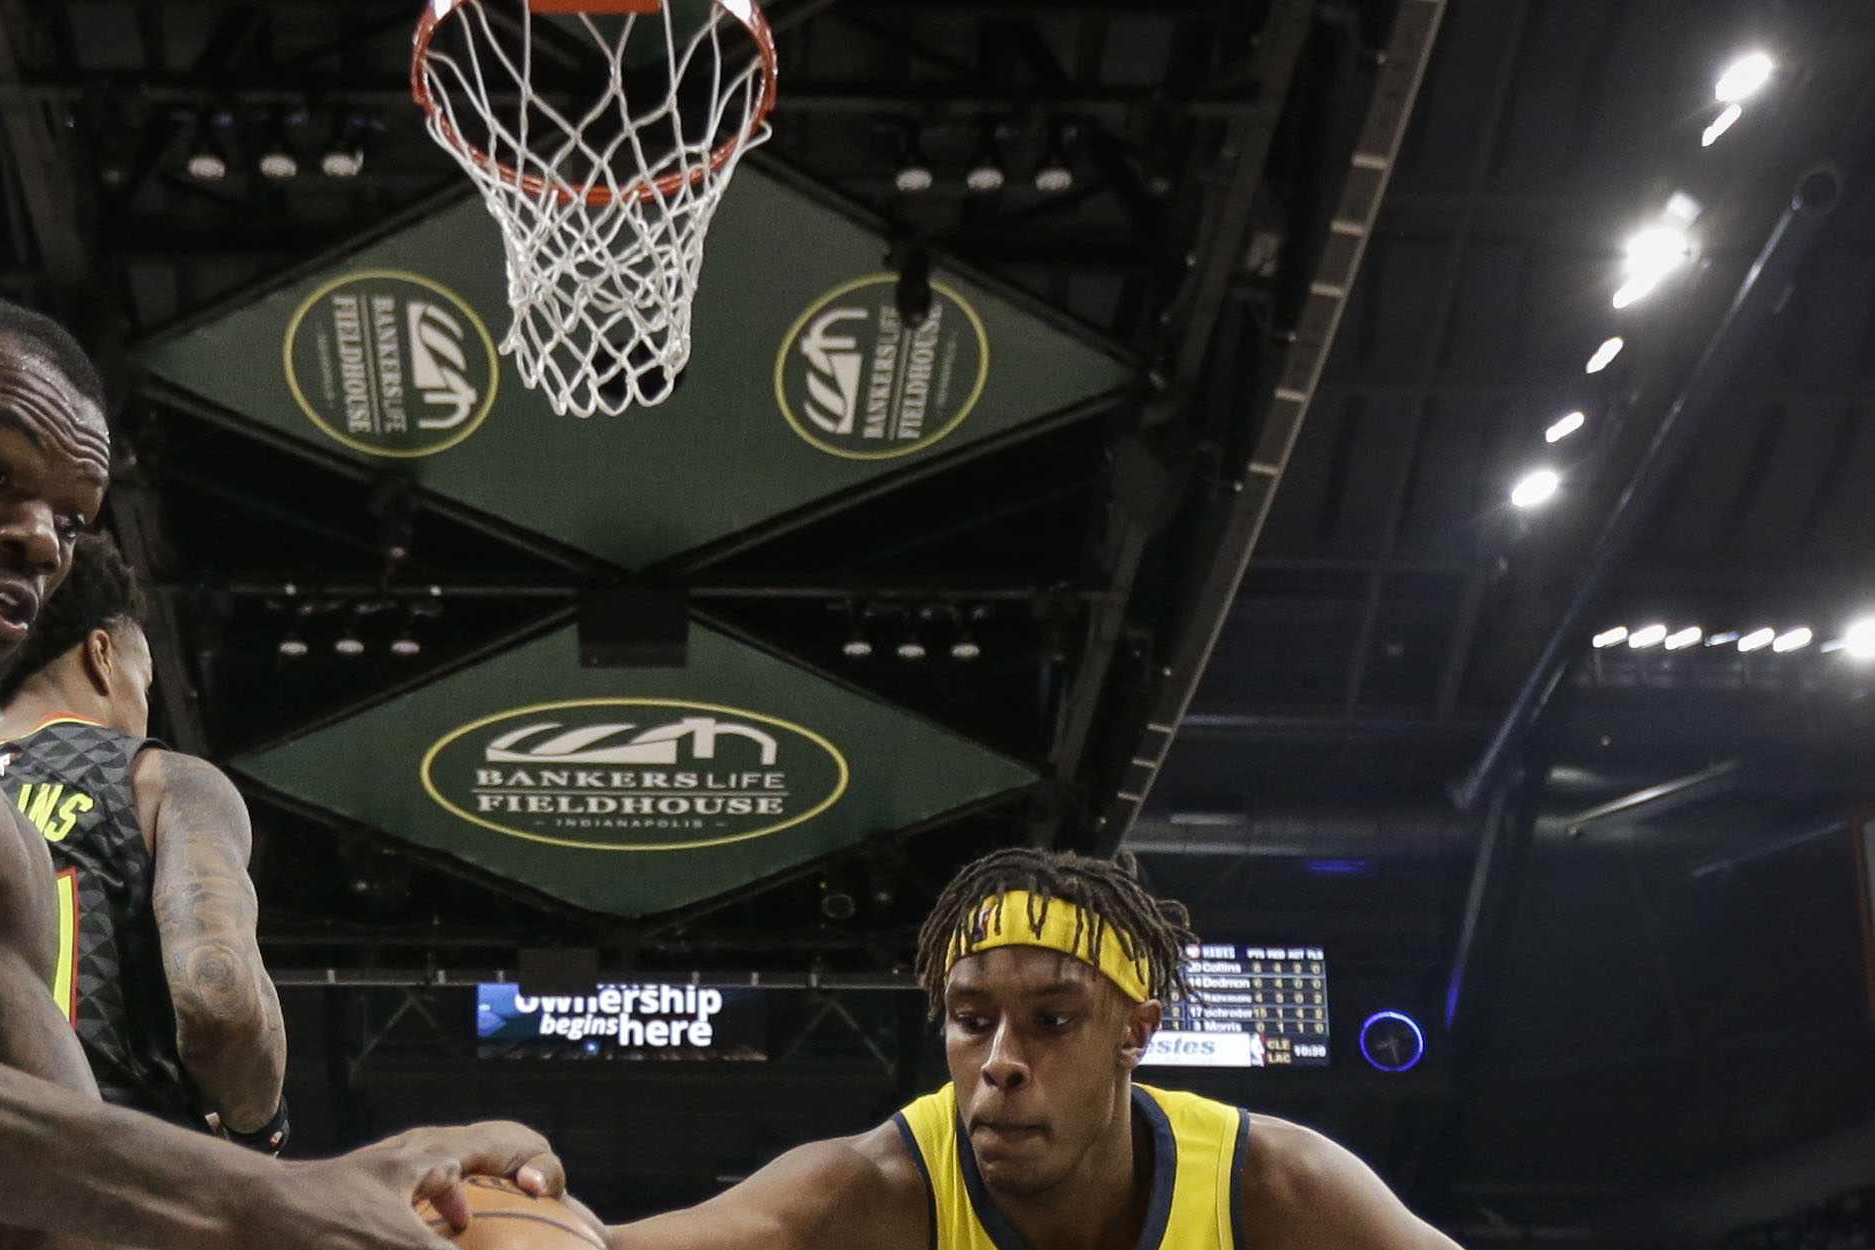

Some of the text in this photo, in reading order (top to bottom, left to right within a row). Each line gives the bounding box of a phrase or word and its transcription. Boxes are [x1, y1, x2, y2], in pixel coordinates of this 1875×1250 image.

[476, 769, 786, 790] BANKERS LIFE
[477, 795, 784, 815] FIELDHOUSE
[556, 819, 704, 829] INDIANAPOLIS
[1202, 961, 1242, 974] Collins
[1202, 978, 1251, 989] Dedmon
[515, 985, 723, 1022] ownership
[539, 1012, 713, 1046] begins here
[1204, 1021, 1242, 1033] Morris
[1266, 1038, 1291, 1050] CLE
